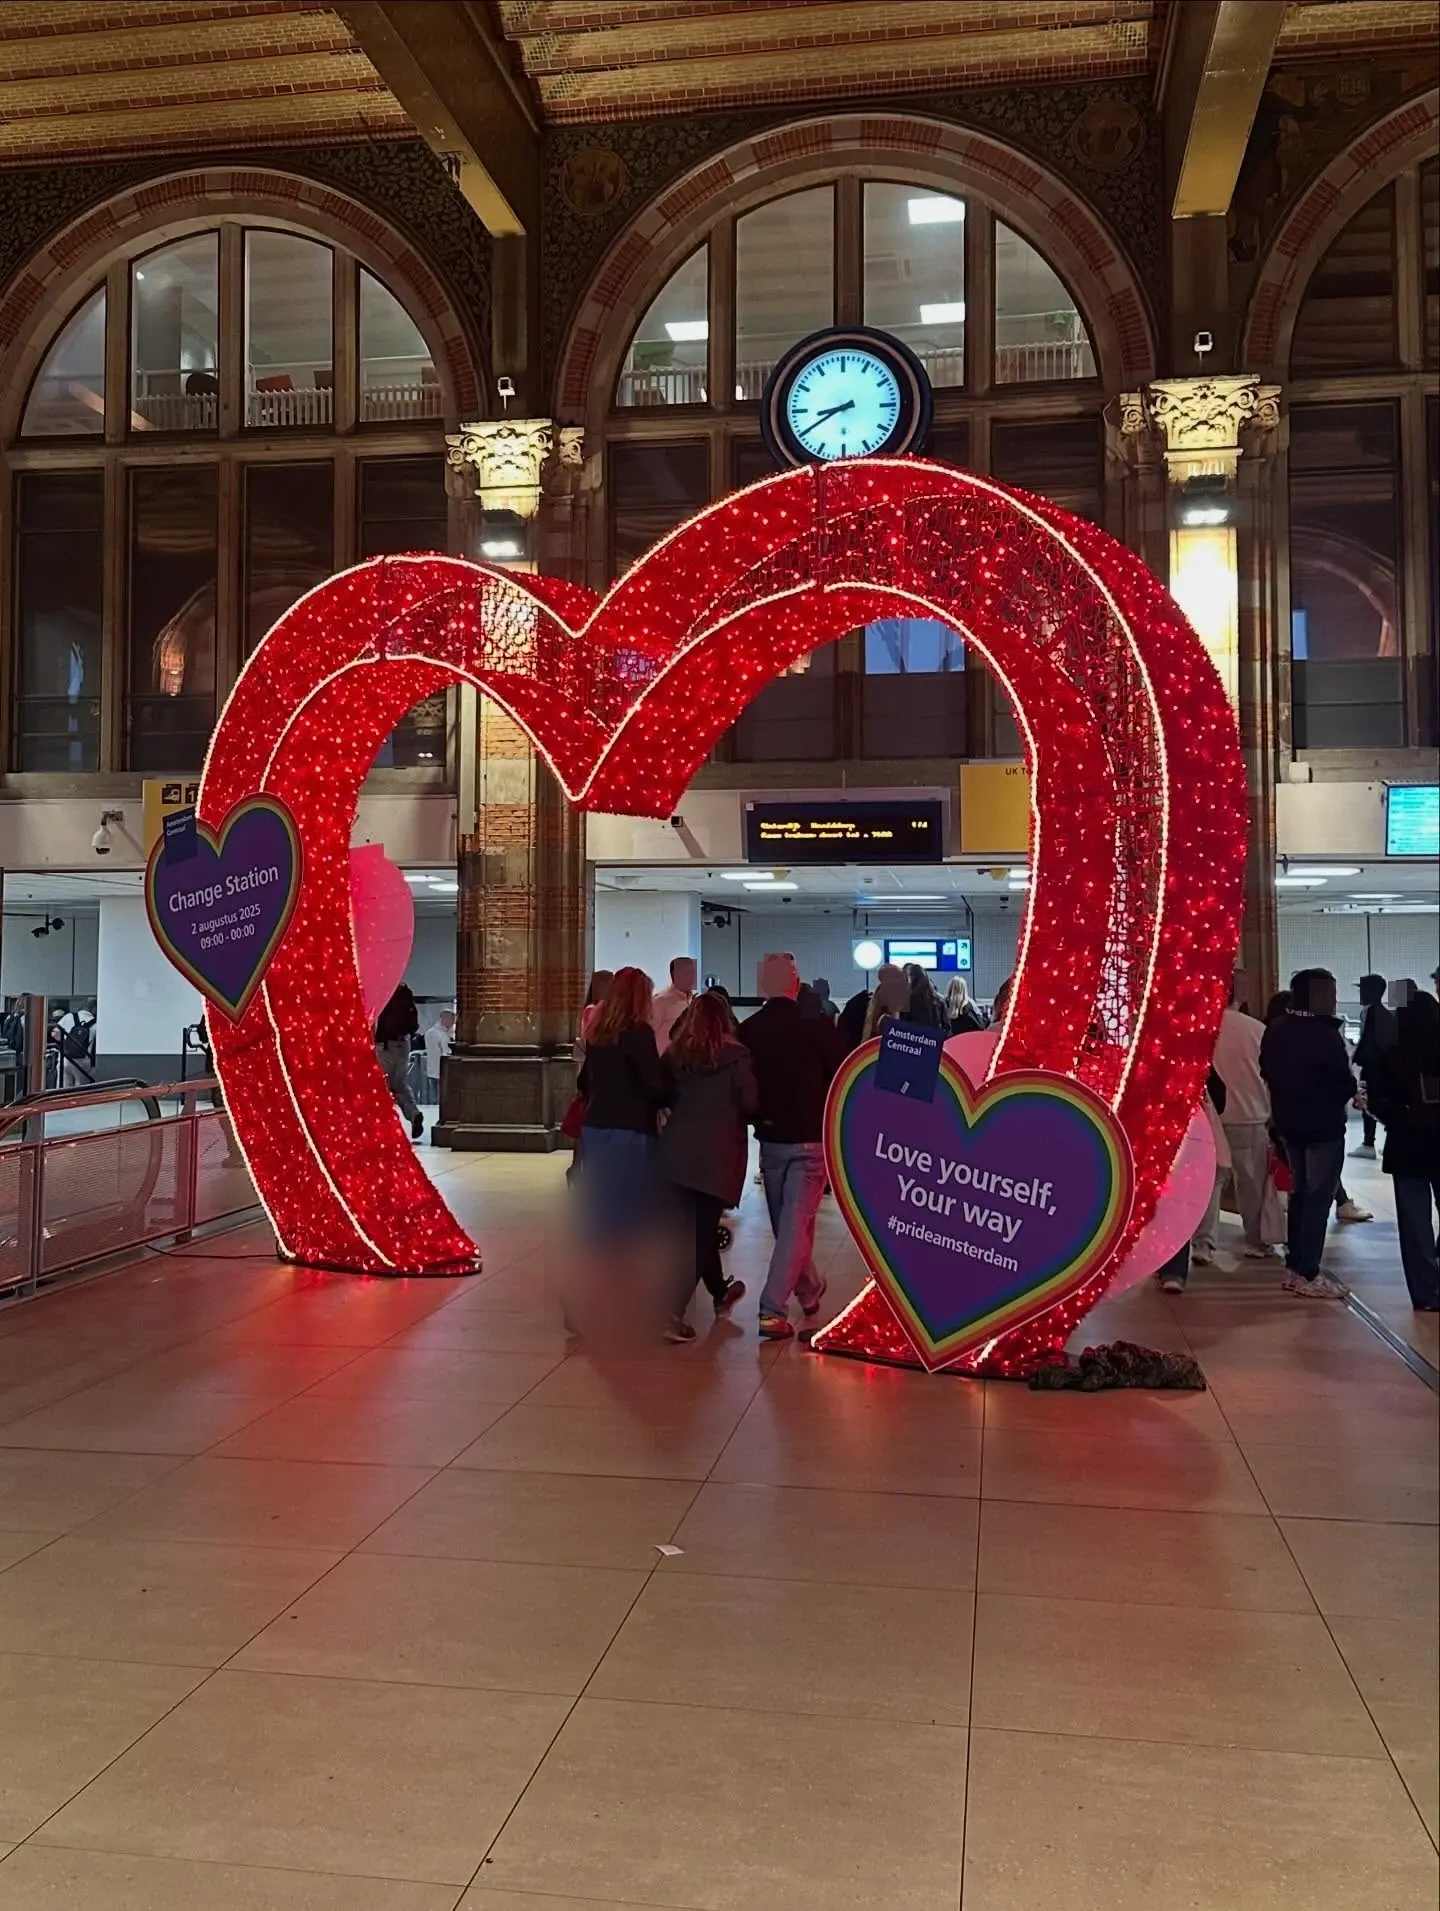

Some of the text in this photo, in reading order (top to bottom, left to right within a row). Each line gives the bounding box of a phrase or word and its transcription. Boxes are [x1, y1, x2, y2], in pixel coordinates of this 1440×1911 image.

[1005, 767, 1018, 776] UK
[169, 866, 279, 913] Change Station
[191, 903, 261, 935] 2 augustus 2025
[200, 932, 224, 950] 09:00
[230, 923, 255, 941] 00:00
[887, 1039, 922, 1056] Centraal
[888, 1027, 937, 1048] Amsterdam
[875, 1132, 1057, 1216] Love yourself,
[897, 1174, 1023, 1243] Your way
[887, 1215, 1019, 1272] #prideamsterdam
